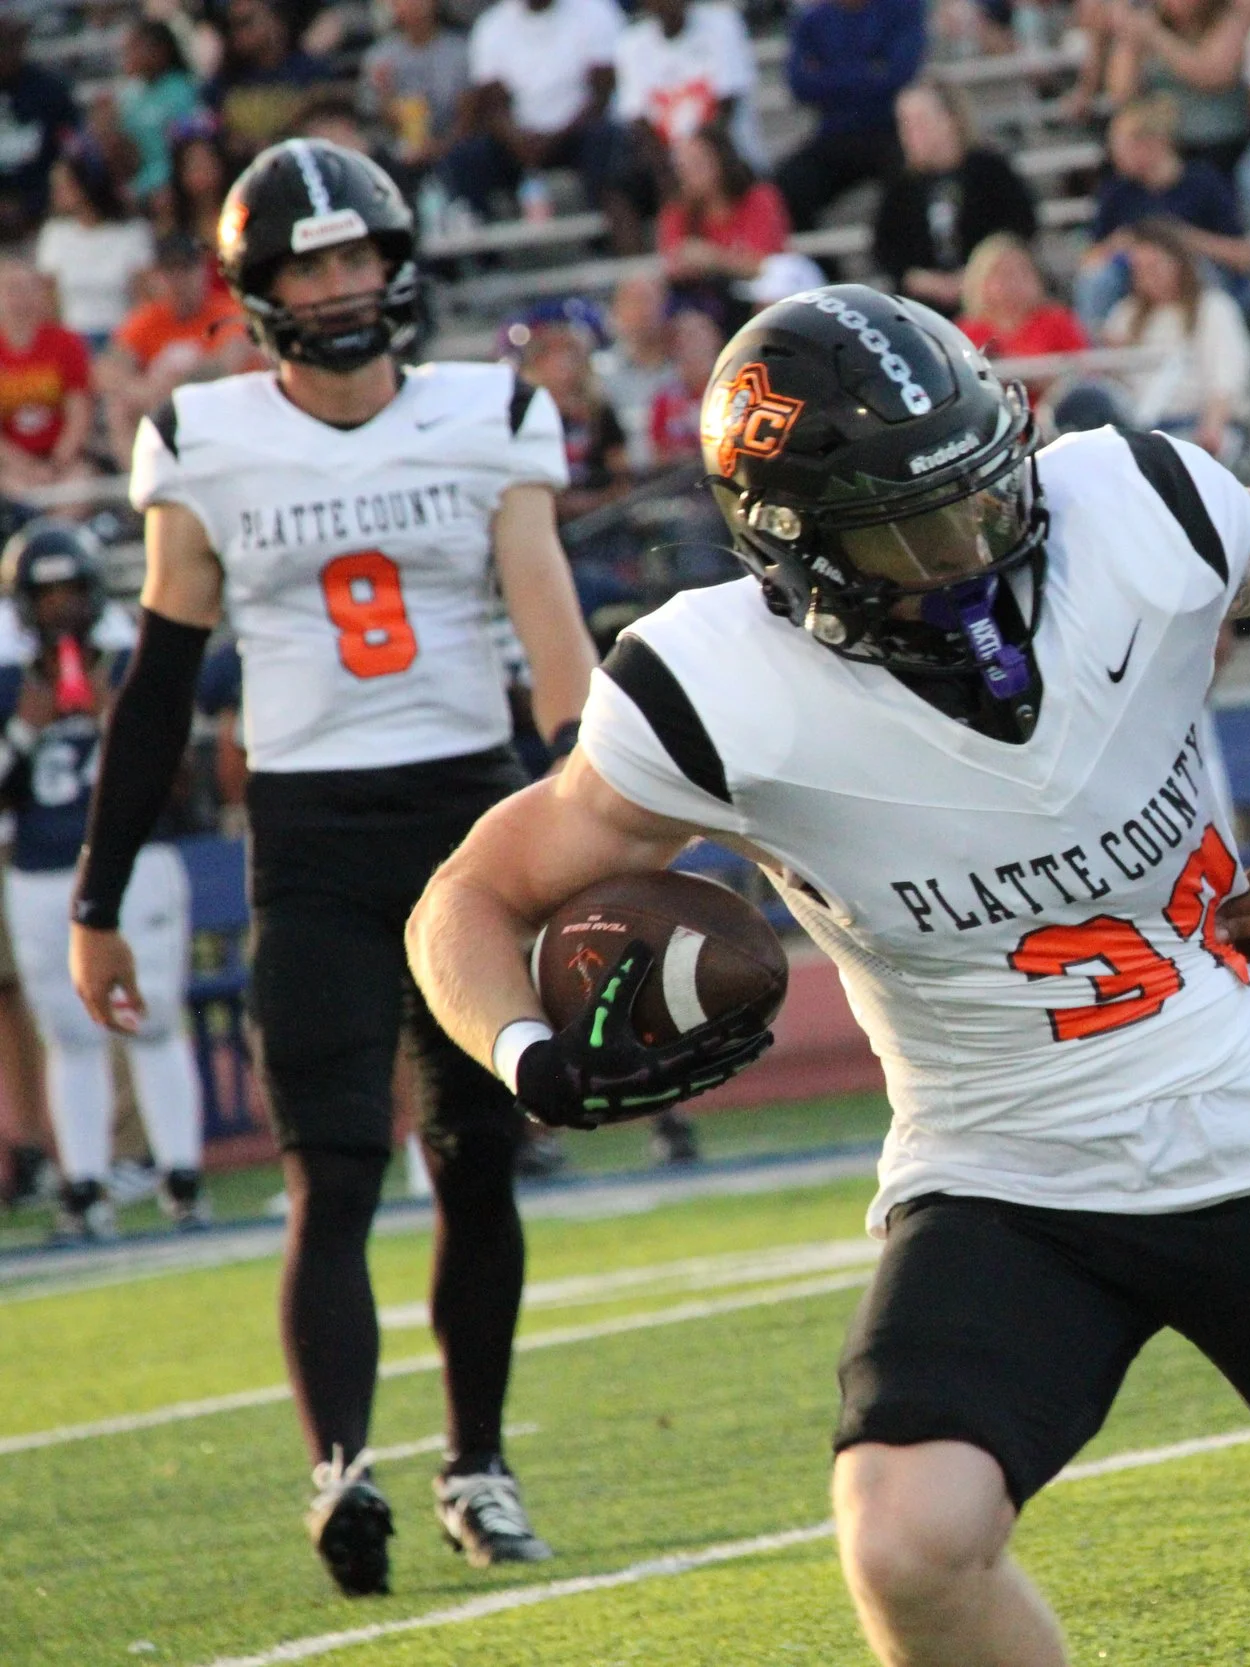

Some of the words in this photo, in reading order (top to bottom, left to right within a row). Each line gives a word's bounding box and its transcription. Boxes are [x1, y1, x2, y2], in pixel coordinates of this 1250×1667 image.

[240, 498, 348, 549] PLATTE
[355, 483, 460, 534] COUNTY
[318, 548, 420, 681] 8
[890, 844, 1112, 933] PLATTE
[1099, 721, 1205, 882] COUNTY
